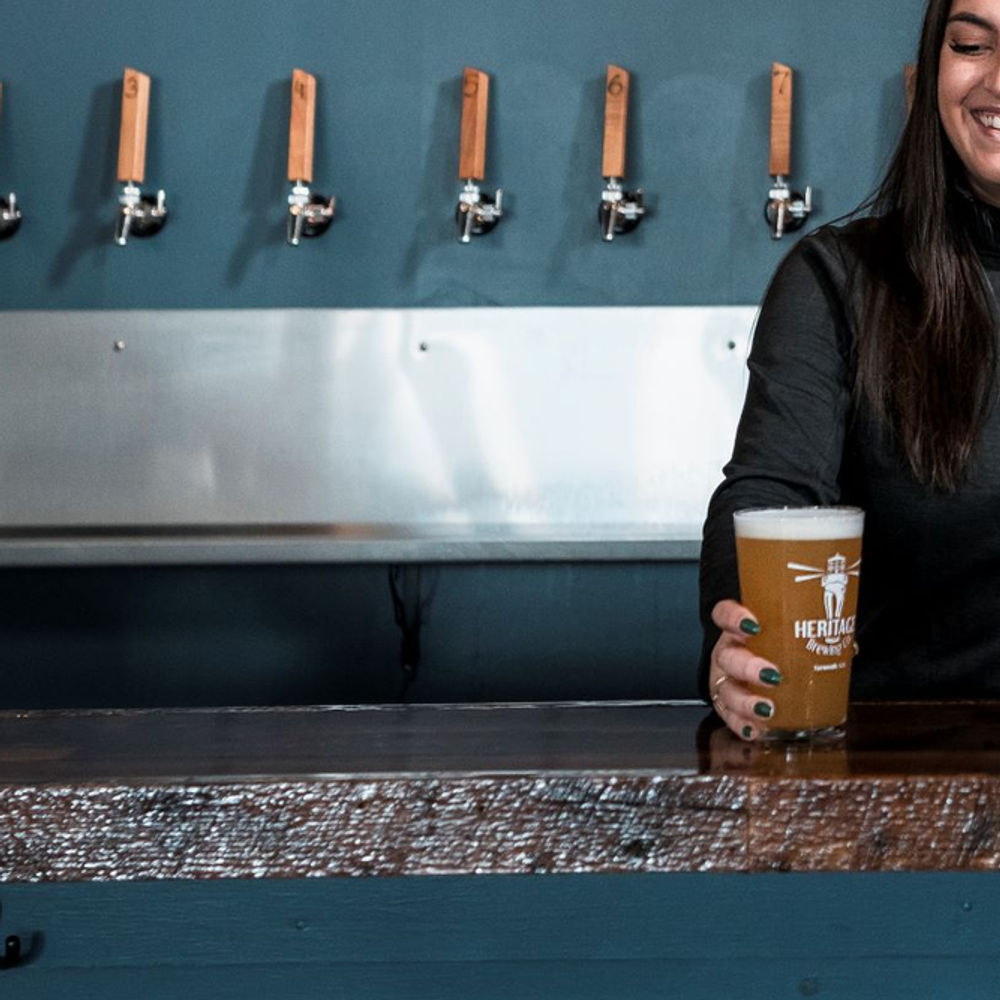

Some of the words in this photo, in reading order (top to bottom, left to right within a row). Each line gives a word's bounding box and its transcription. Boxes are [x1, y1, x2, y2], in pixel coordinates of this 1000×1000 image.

[123, 76, 139, 99] 3
[607, 74, 623, 97] 6
[772, 69, 789, 98] 7
